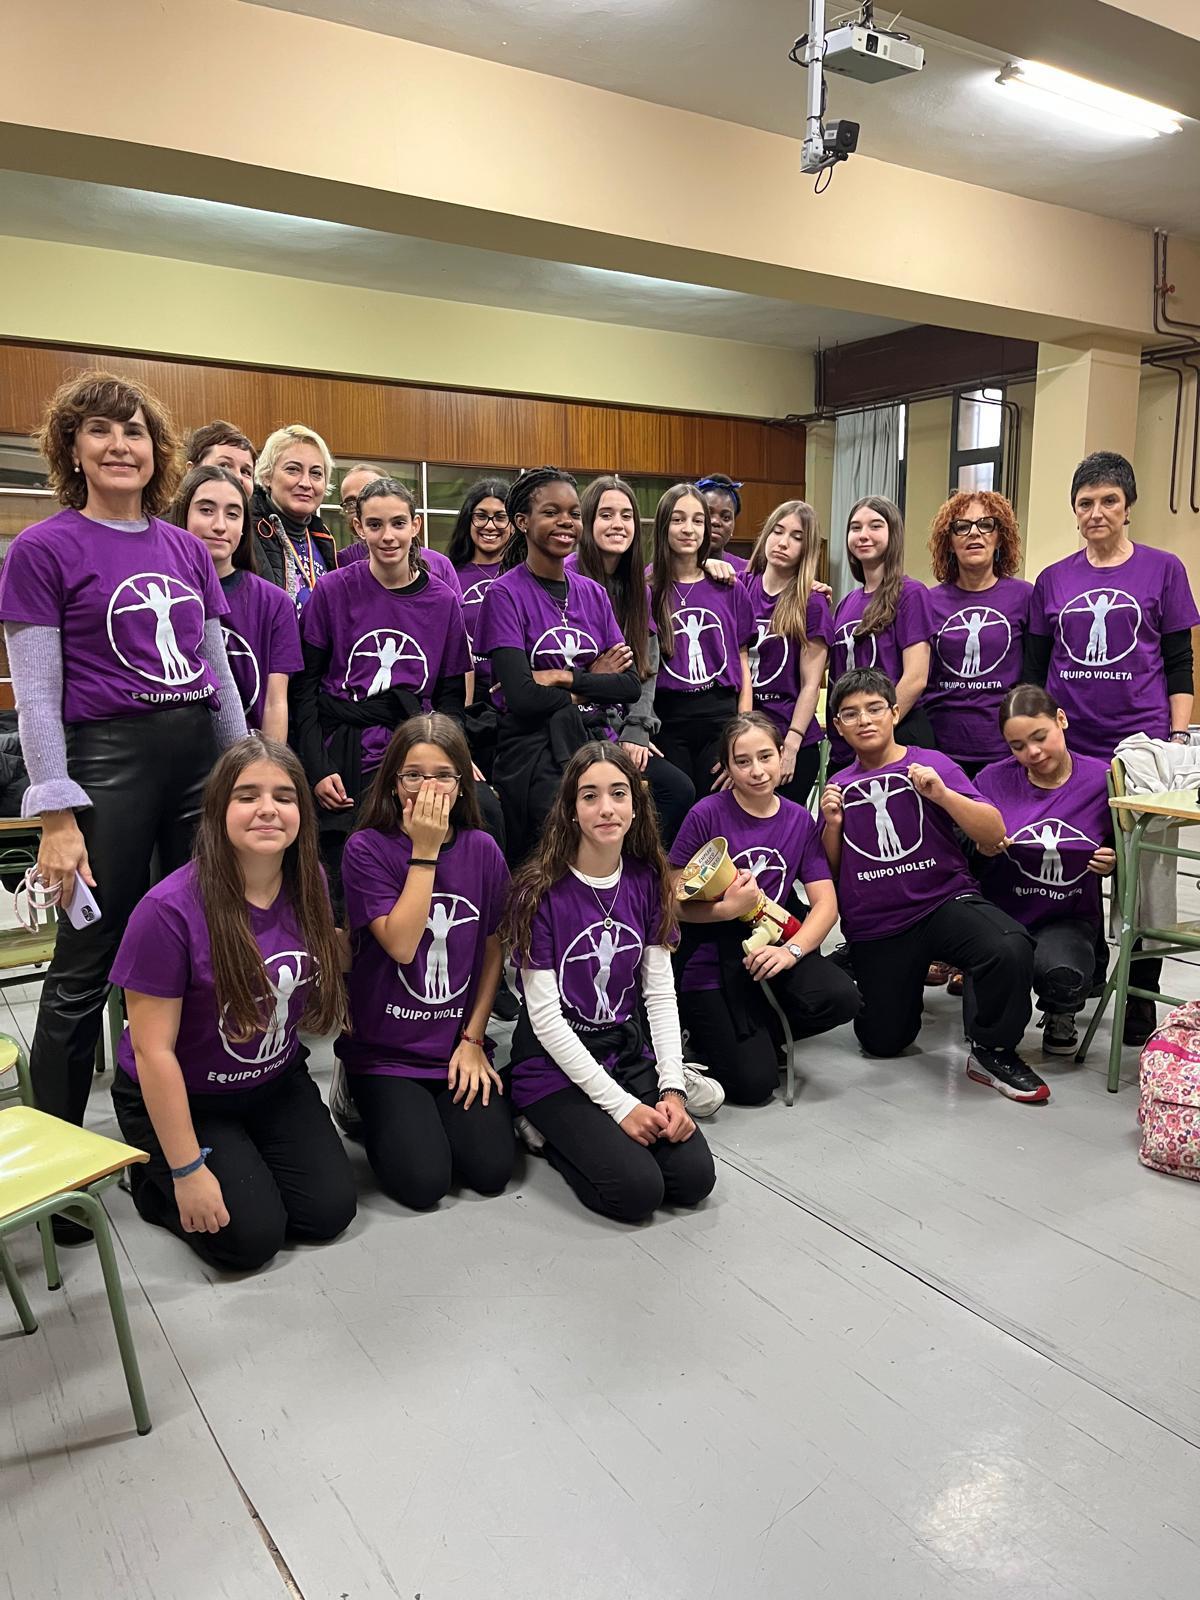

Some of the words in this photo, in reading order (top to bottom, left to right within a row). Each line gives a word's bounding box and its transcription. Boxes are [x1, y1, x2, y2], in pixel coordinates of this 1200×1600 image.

[1060, 670, 1092, 680] EQUIPO
[1094, 671, 1133, 680] VIOLETA
[967, 681, 1002, 689] VIOLETA
[857, 868, 894, 881] EQUIPO
[895, 858, 936, 874] VIOLETA
[1015, 886, 1047, 897] QUIPO
[385, 1003, 431, 1020] EQUIPO
[433, 1007, 464, 1019] VIOLE
[207, 1071, 261, 1084] EQUIPO
